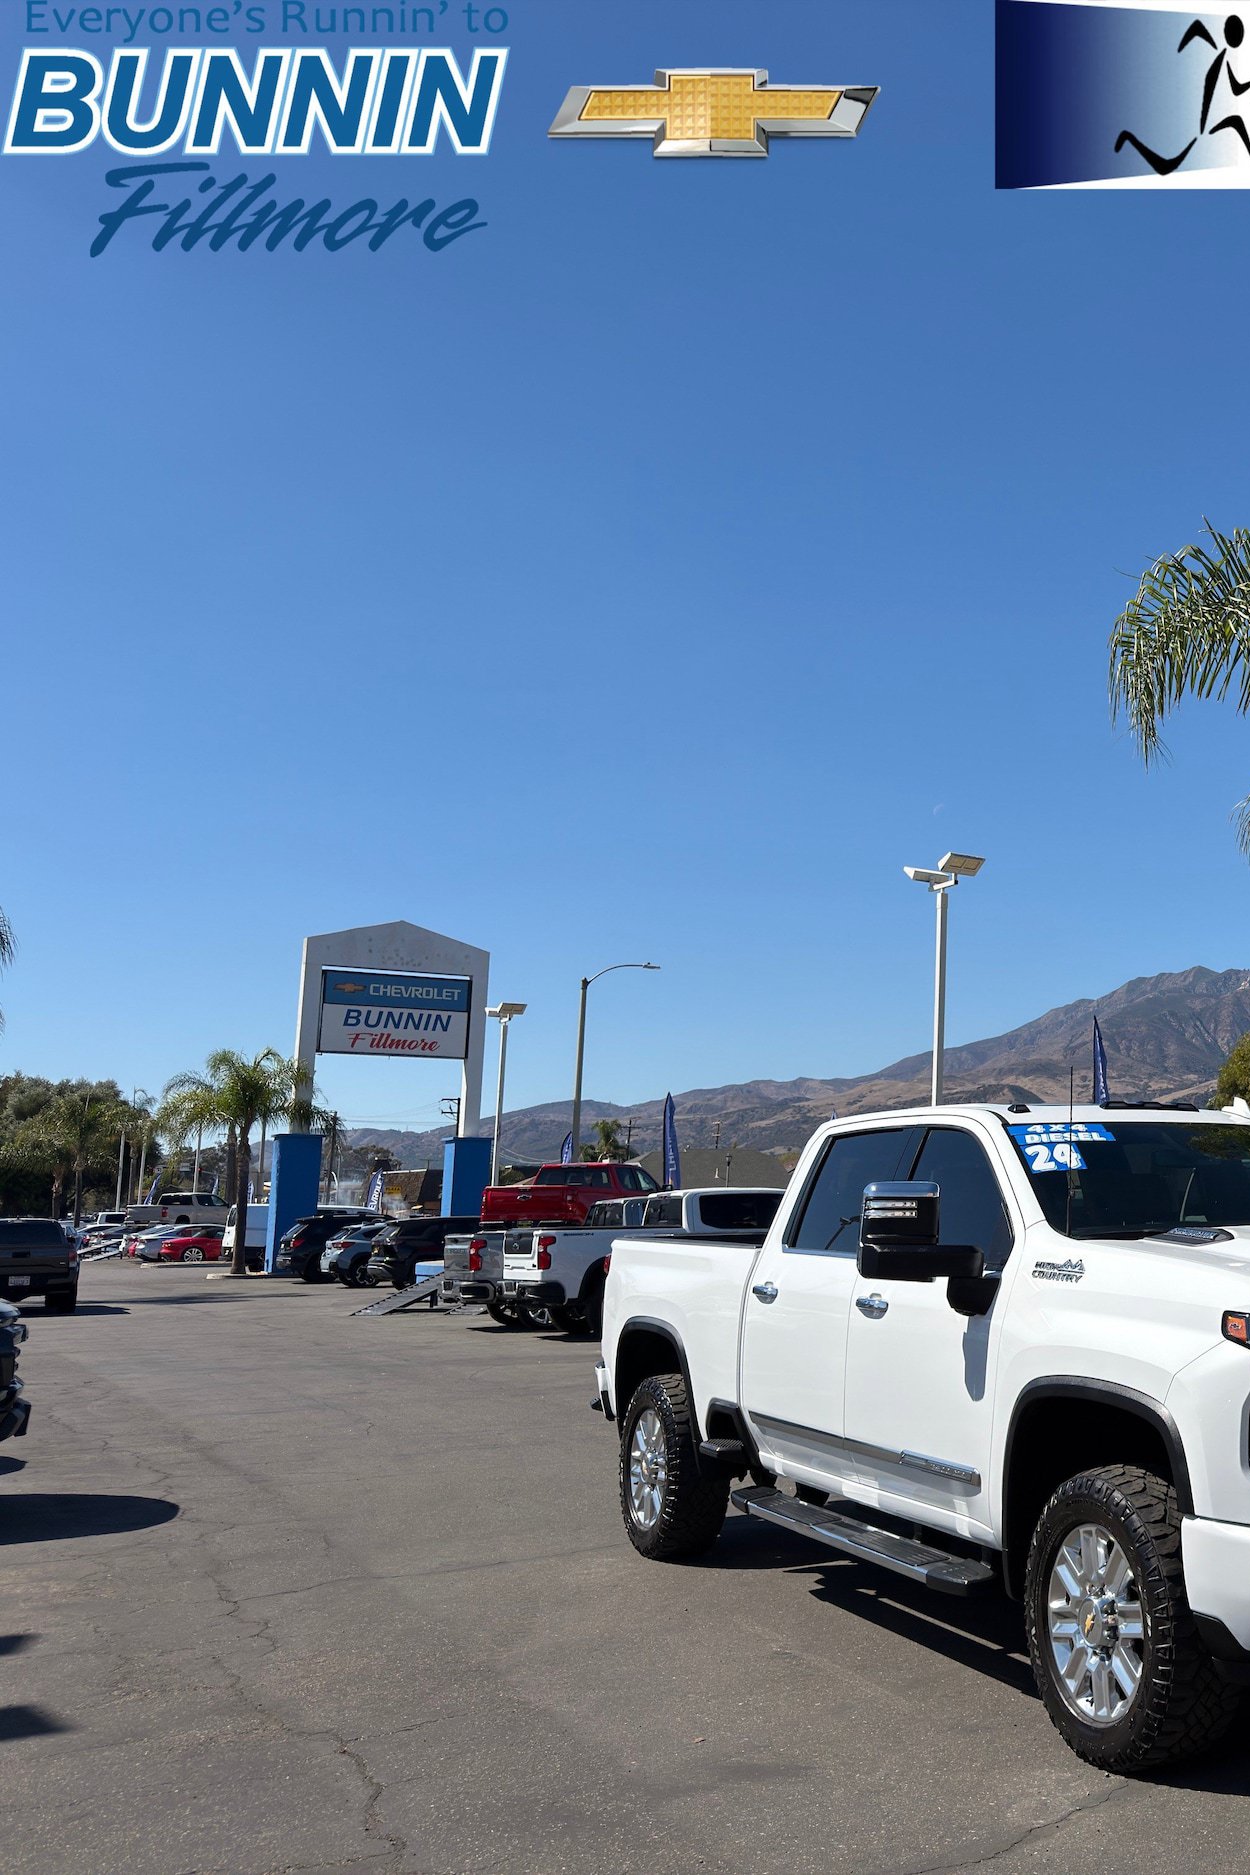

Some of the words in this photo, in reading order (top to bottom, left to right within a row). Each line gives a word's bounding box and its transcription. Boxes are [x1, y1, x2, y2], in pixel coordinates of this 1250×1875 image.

[369, 983, 462, 1001] CHEVROLET
[343, 1008, 452, 1032] BUNNIN
[347, 1032, 440, 1052] Fillmore
[1025, 1132, 1106, 1144] DIESEL
[1032, 1270, 1083, 1283] COUNTRY
